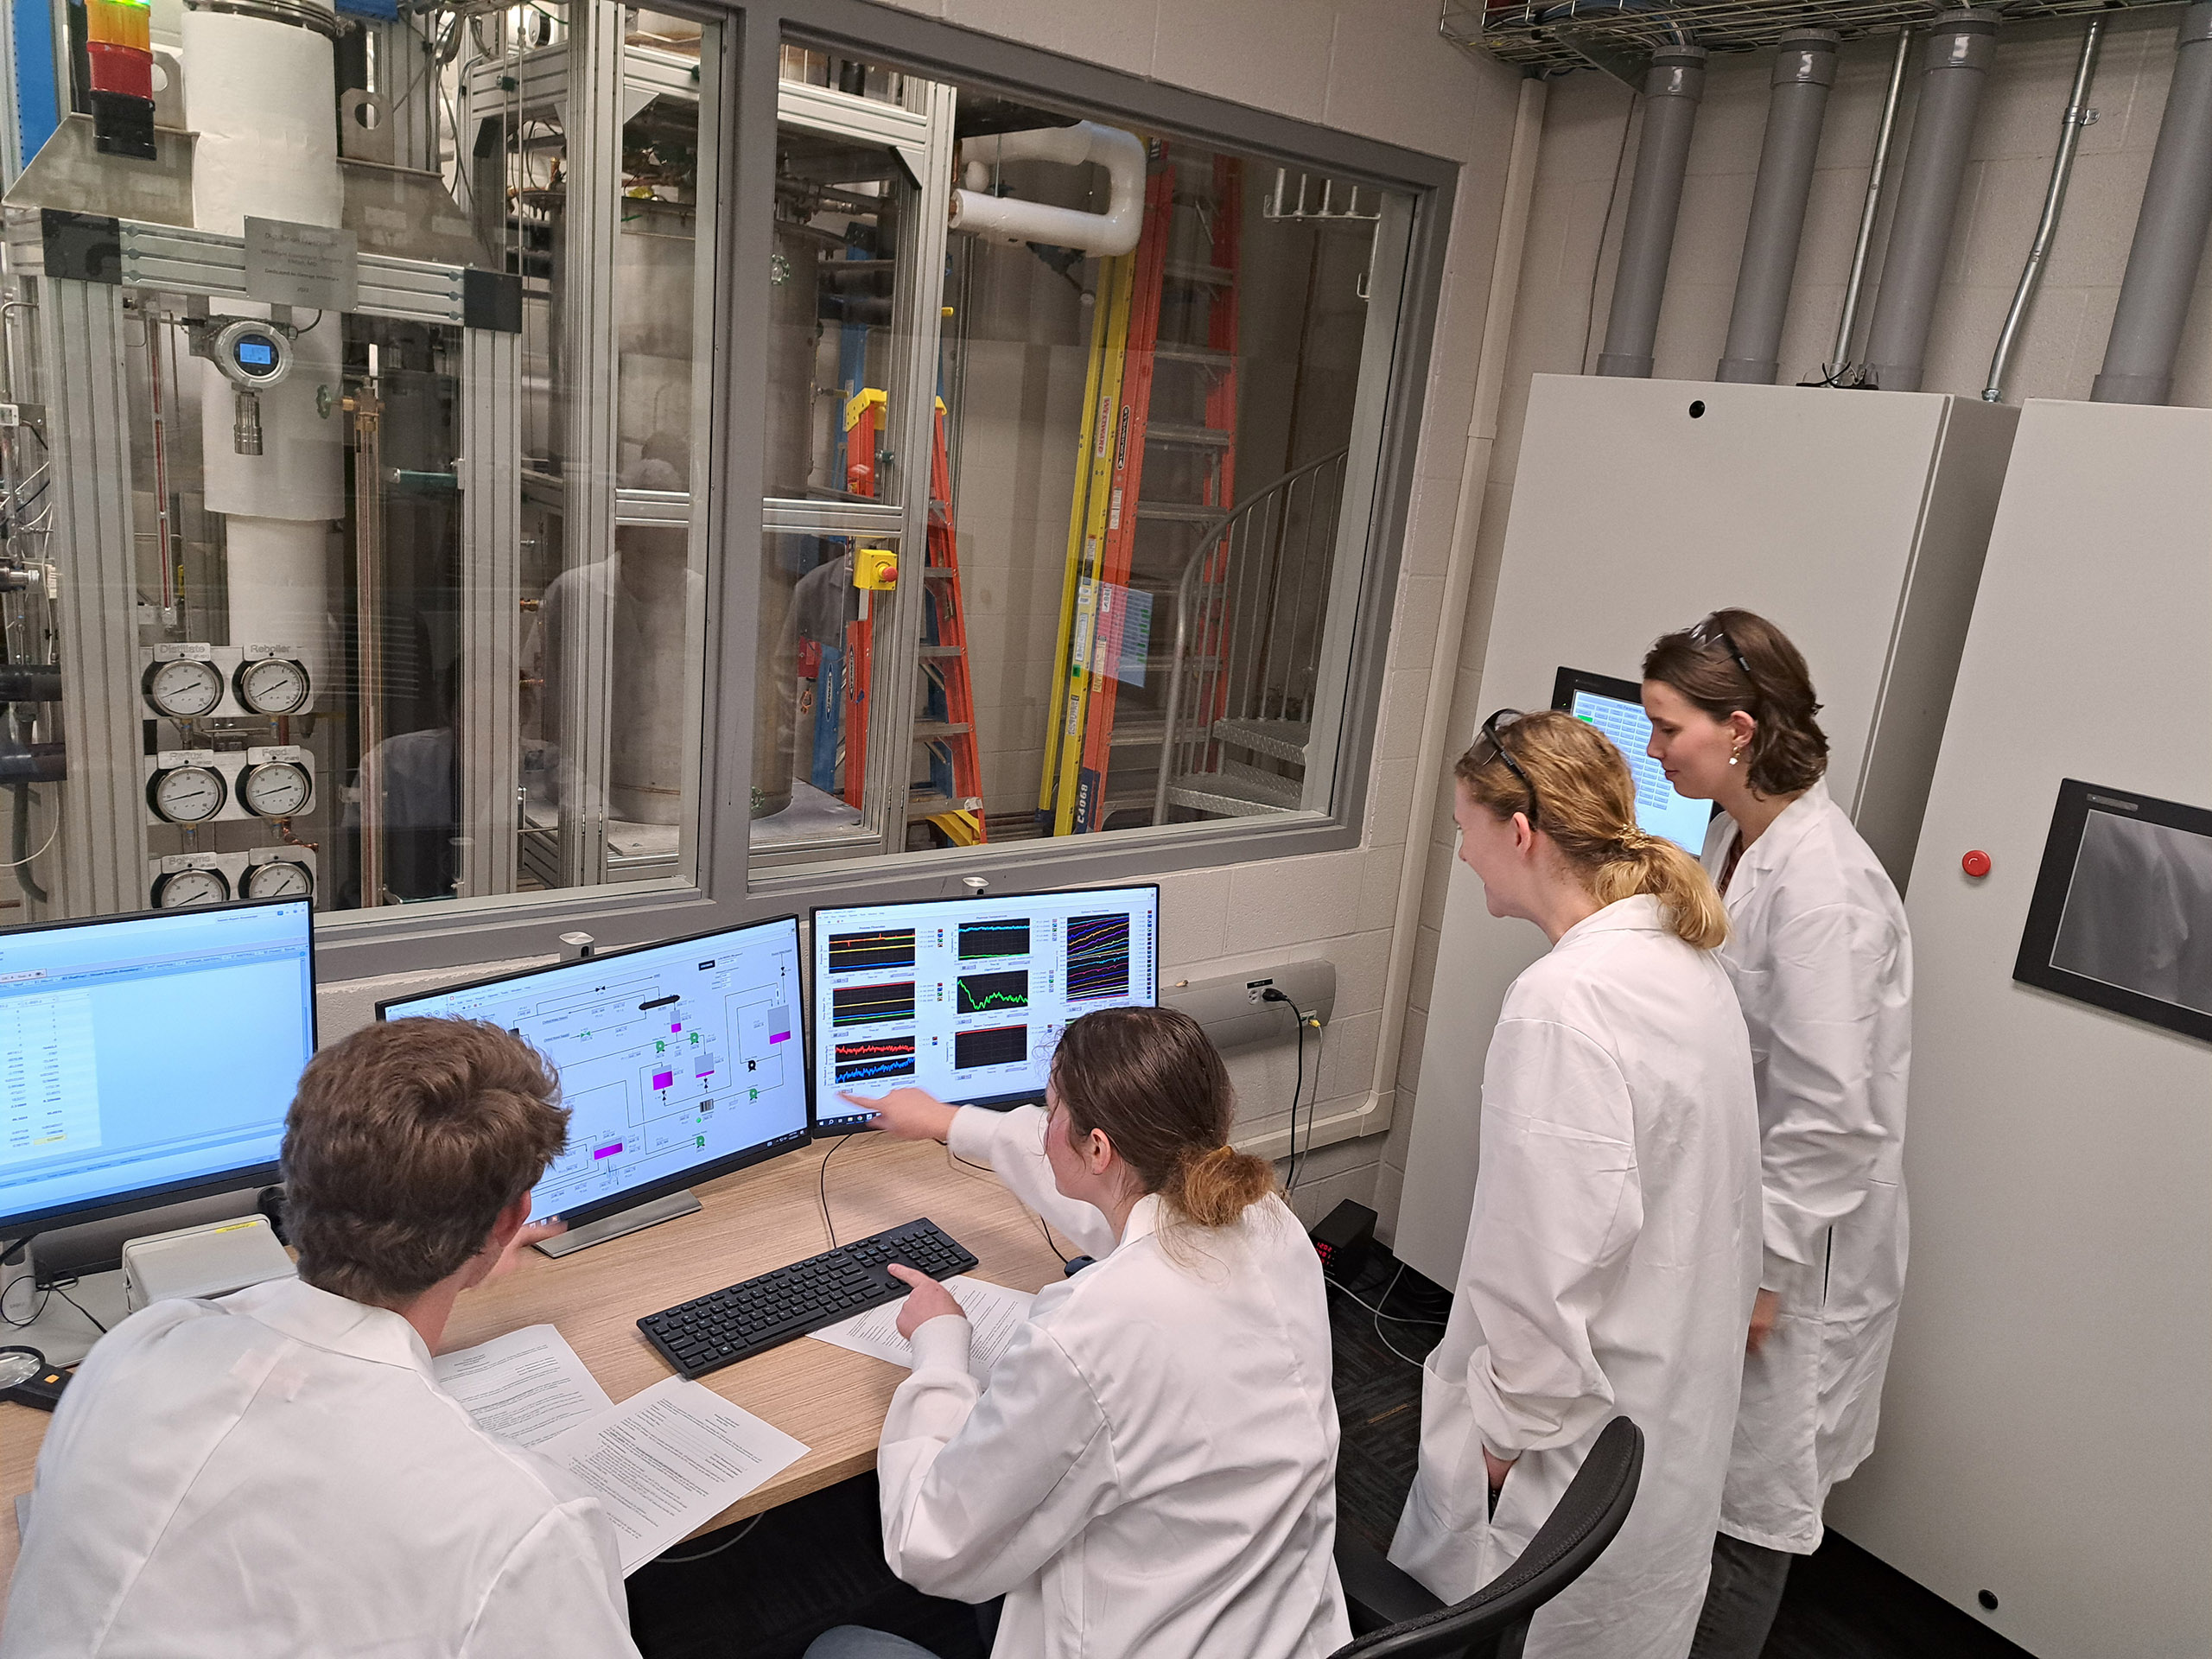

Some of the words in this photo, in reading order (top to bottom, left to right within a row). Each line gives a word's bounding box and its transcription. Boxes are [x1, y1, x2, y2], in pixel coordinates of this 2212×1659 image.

[1098, 399, 1110, 454] WESTWARD
[1119, 407, 1128, 460] LOUISVILLE
[159, 644, 206, 654] Distillate
[250, 644, 291, 653] Reboiler
[168, 752, 203, 761] Reflux
[261, 747, 289, 758] Feed
[1077, 783, 1089, 824] C4068
[168, 855, 211, 865] Bottoms
